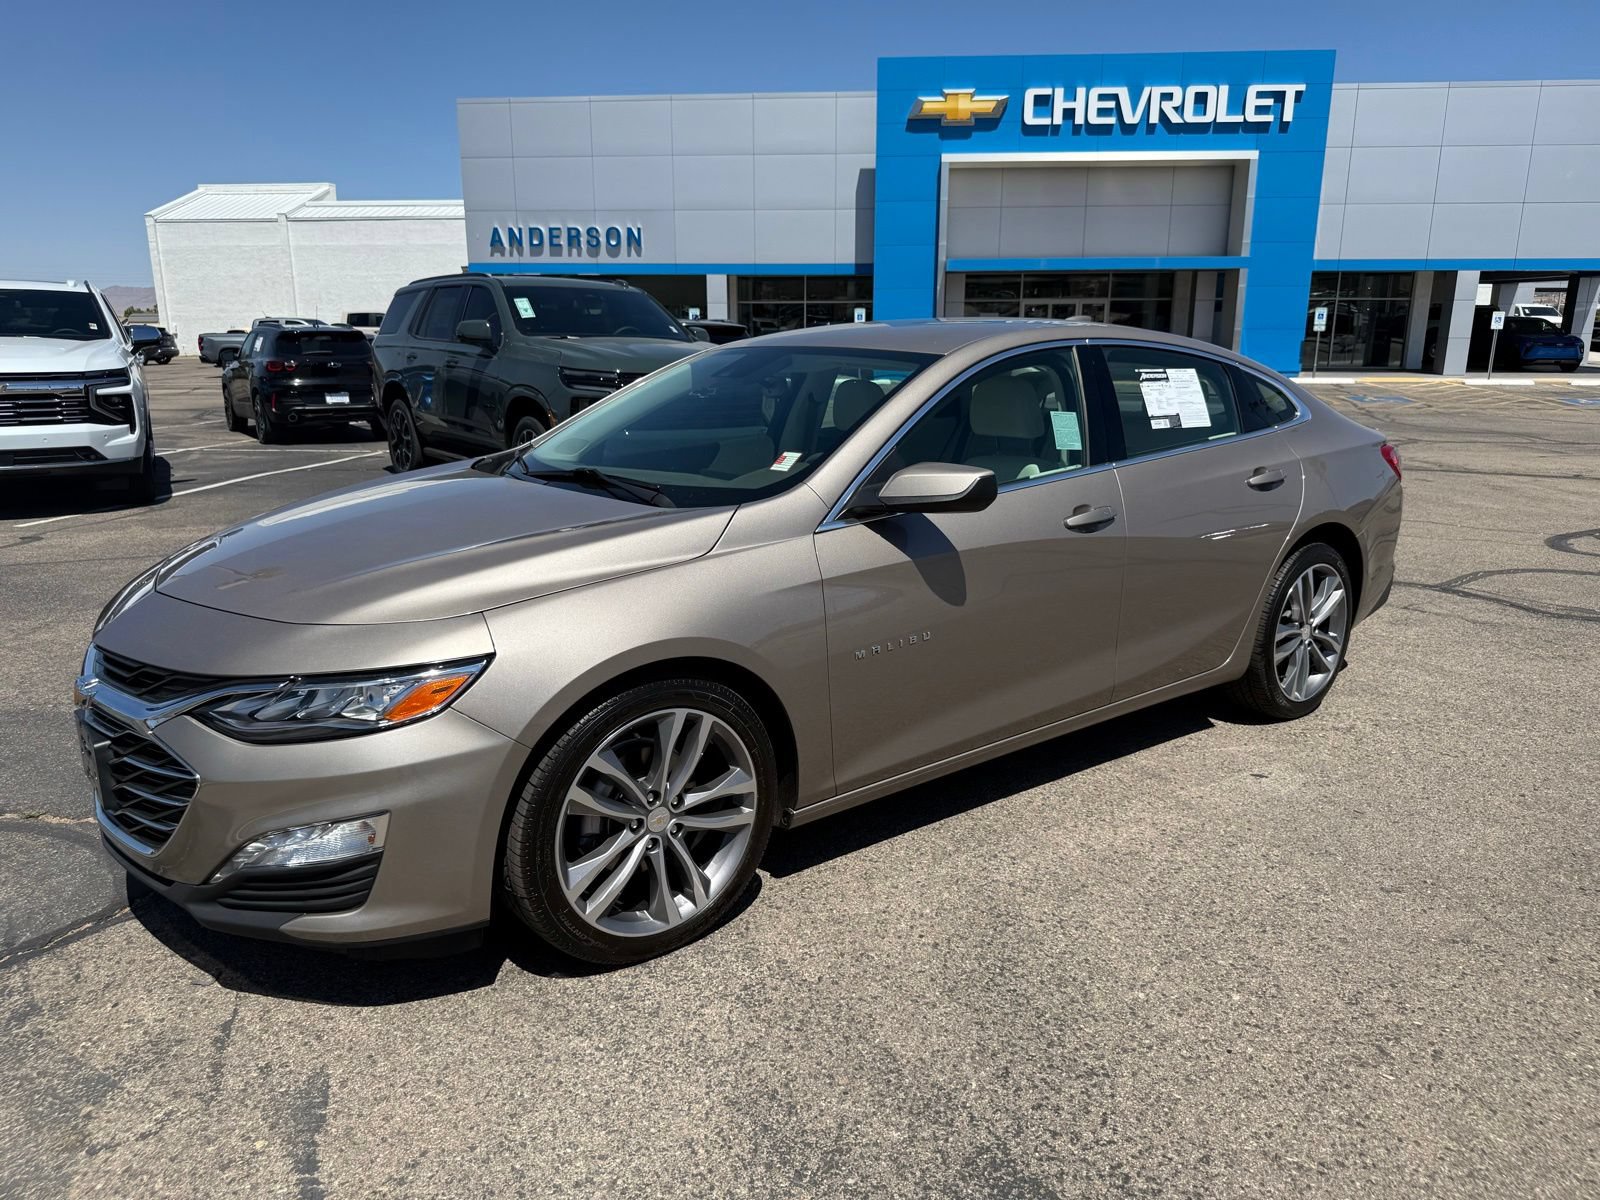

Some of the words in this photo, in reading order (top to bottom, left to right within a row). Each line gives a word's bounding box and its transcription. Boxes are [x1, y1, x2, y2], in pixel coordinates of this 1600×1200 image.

[1023, 83, 1306, 126] CHEVROLET
[489, 226, 643, 249] ANDERSON
[854, 631, 931, 661] MALIBU
